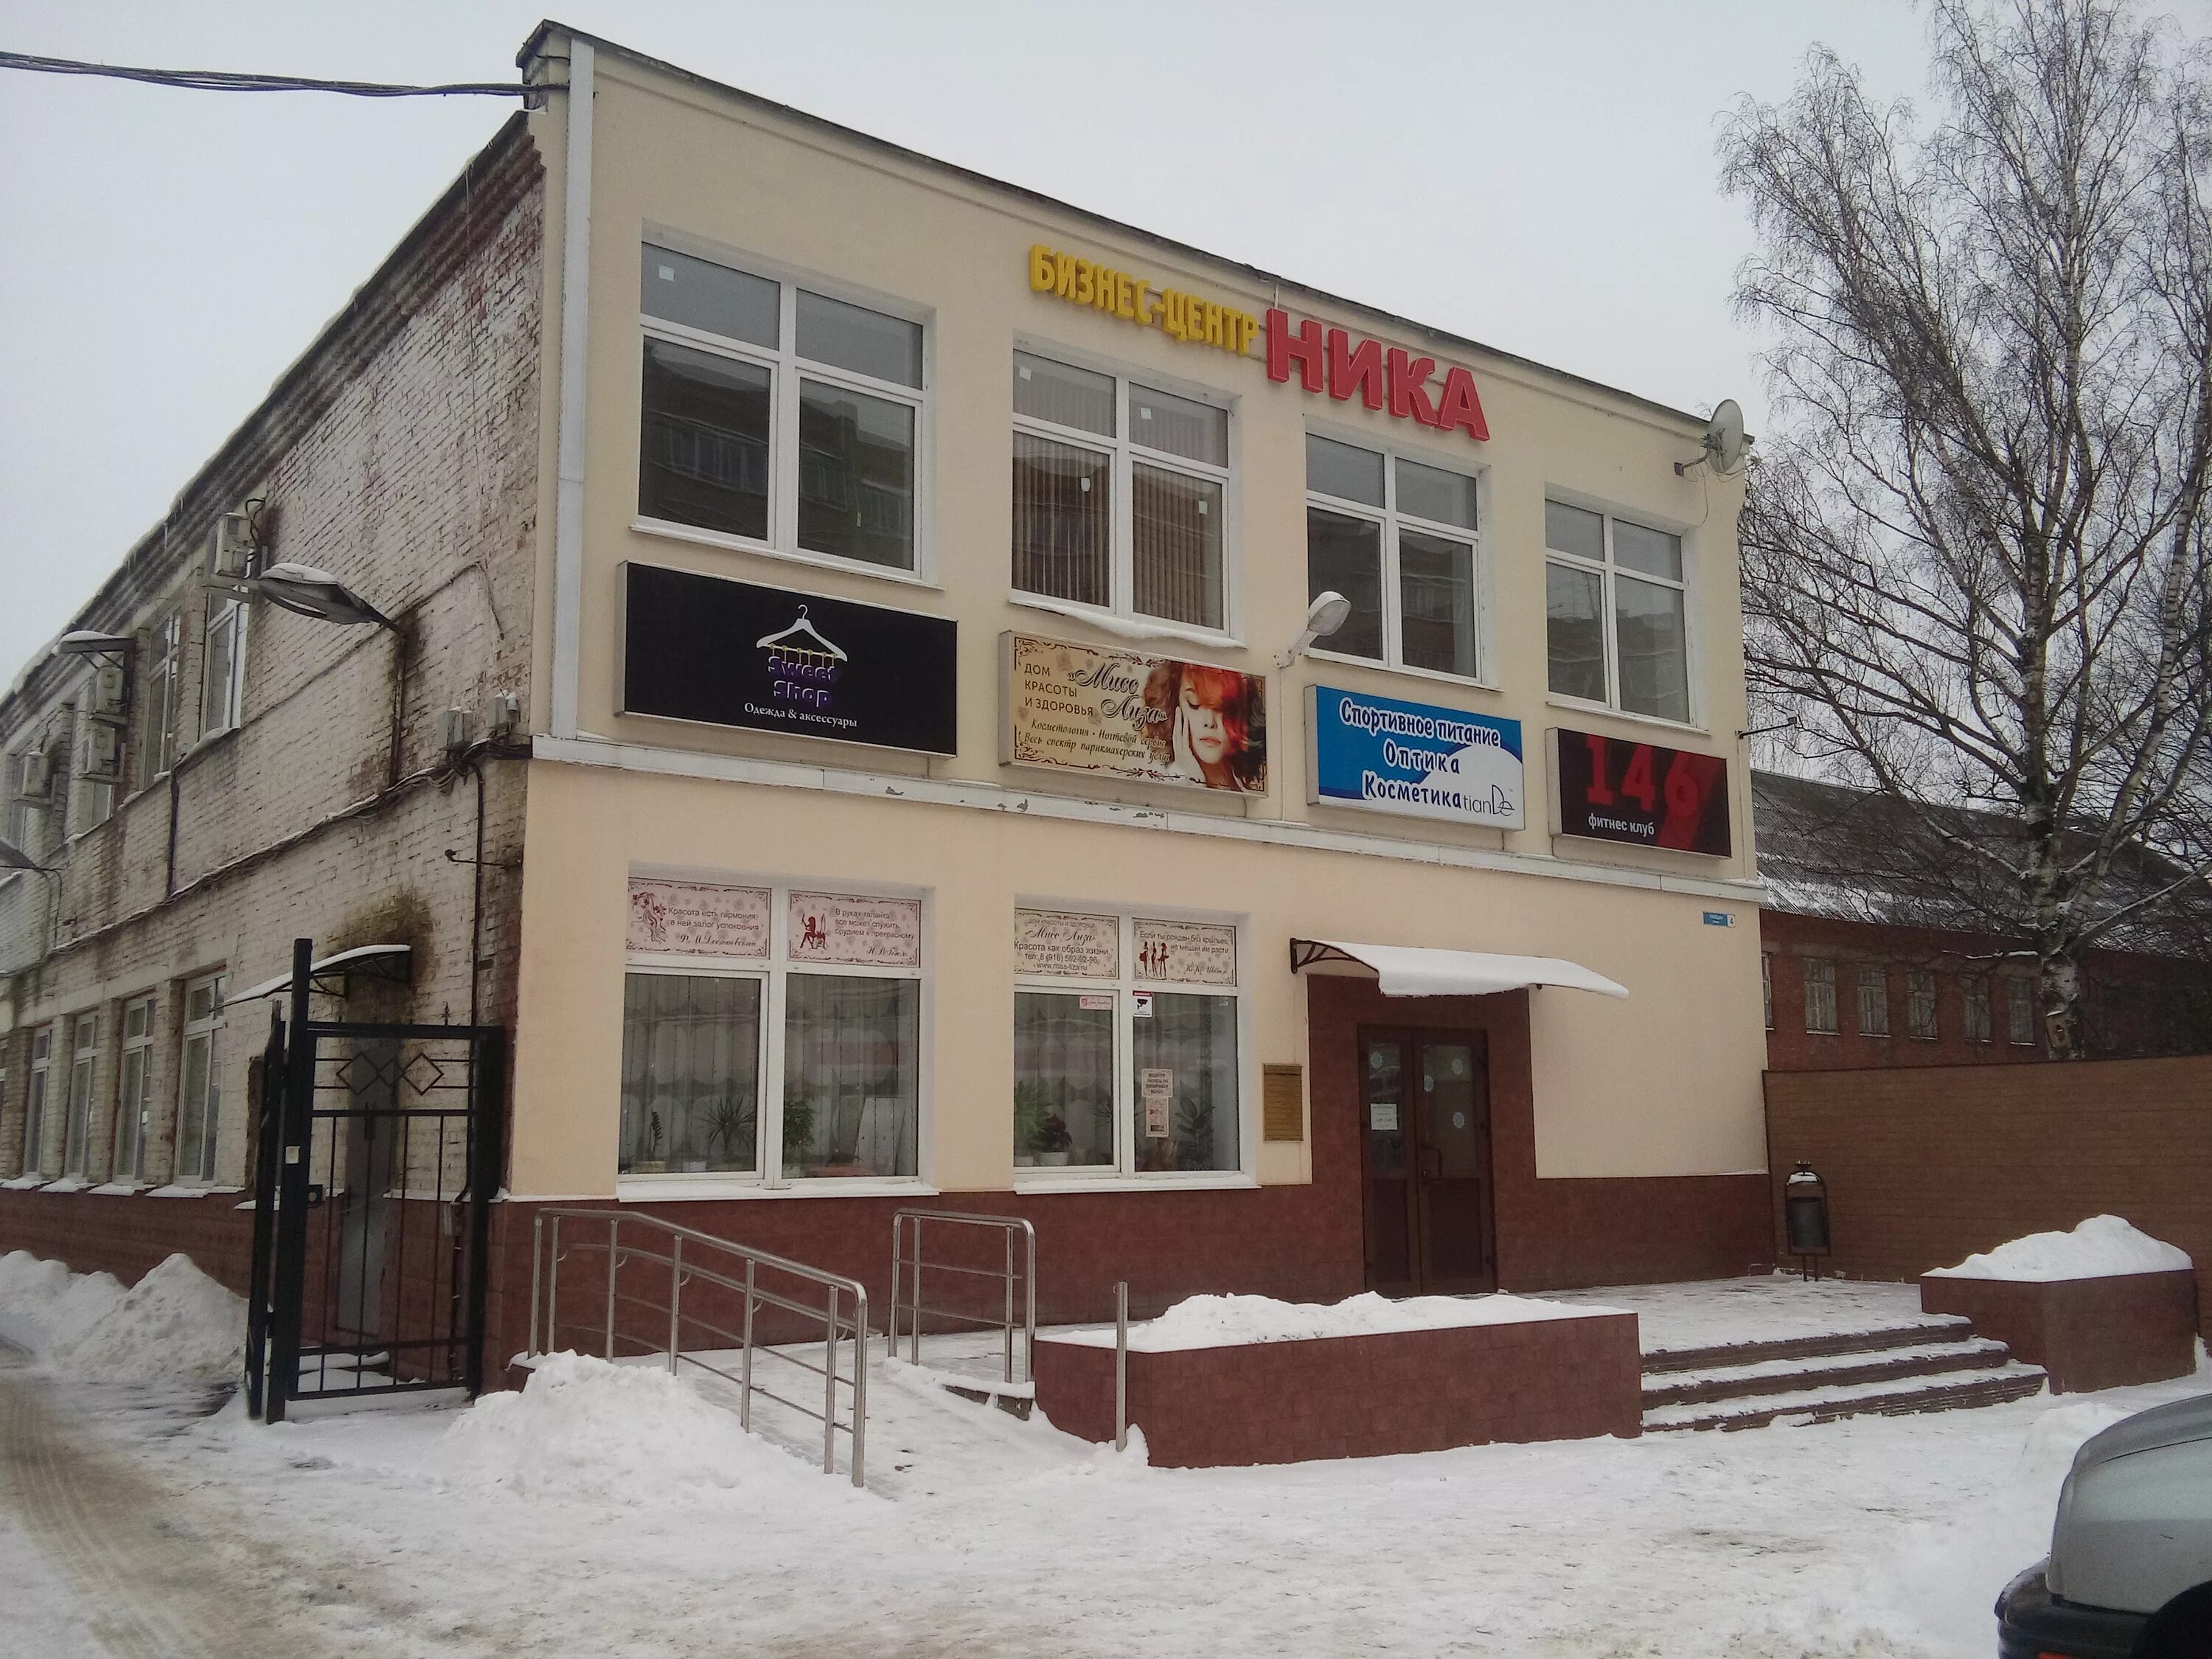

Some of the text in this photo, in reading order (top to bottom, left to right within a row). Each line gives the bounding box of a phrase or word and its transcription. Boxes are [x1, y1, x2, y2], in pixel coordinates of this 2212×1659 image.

[1029, 244, 1259, 356] БИЗНЕС-ЦЕНТР
[1266, 307, 1490, 442] НИКА
[767, 655, 836, 681] Sweet
[1024, 663, 1051, 678] ДОМ
[773, 680, 831, 709] Shop
[1024, 681, 1077, 698] КРАСОТЫ
[744, 702, 858, 728] Одежда & аксессуары
[1025, 697, 1093, 717] И ЗДОРОВЬЯ
[1031, 718, 1090, 737] Косметология
[1099, 728, 1138, 746] Ногтевой
[1340, 700, 1500, 747] Спортивное питание
[1024, 733, 1043, 745] Весь
[1046, 739, 1077, 753] спектр
[1080, 743, 1146, 760] парикмахерских
[1385, 740, 1460, 775] Оптика
[1586, 734, 1699, 817] 146
[1365, 774, 1461, 810] Косметика
[1587, 813, 1655, 838] фитнес клуб
[668, 907, 700, 916] Красота
[1014, 941, 1046, 950] Красота
[1048, 944, 1060, 952] как
[1062, 945, 1084, 954] образ
